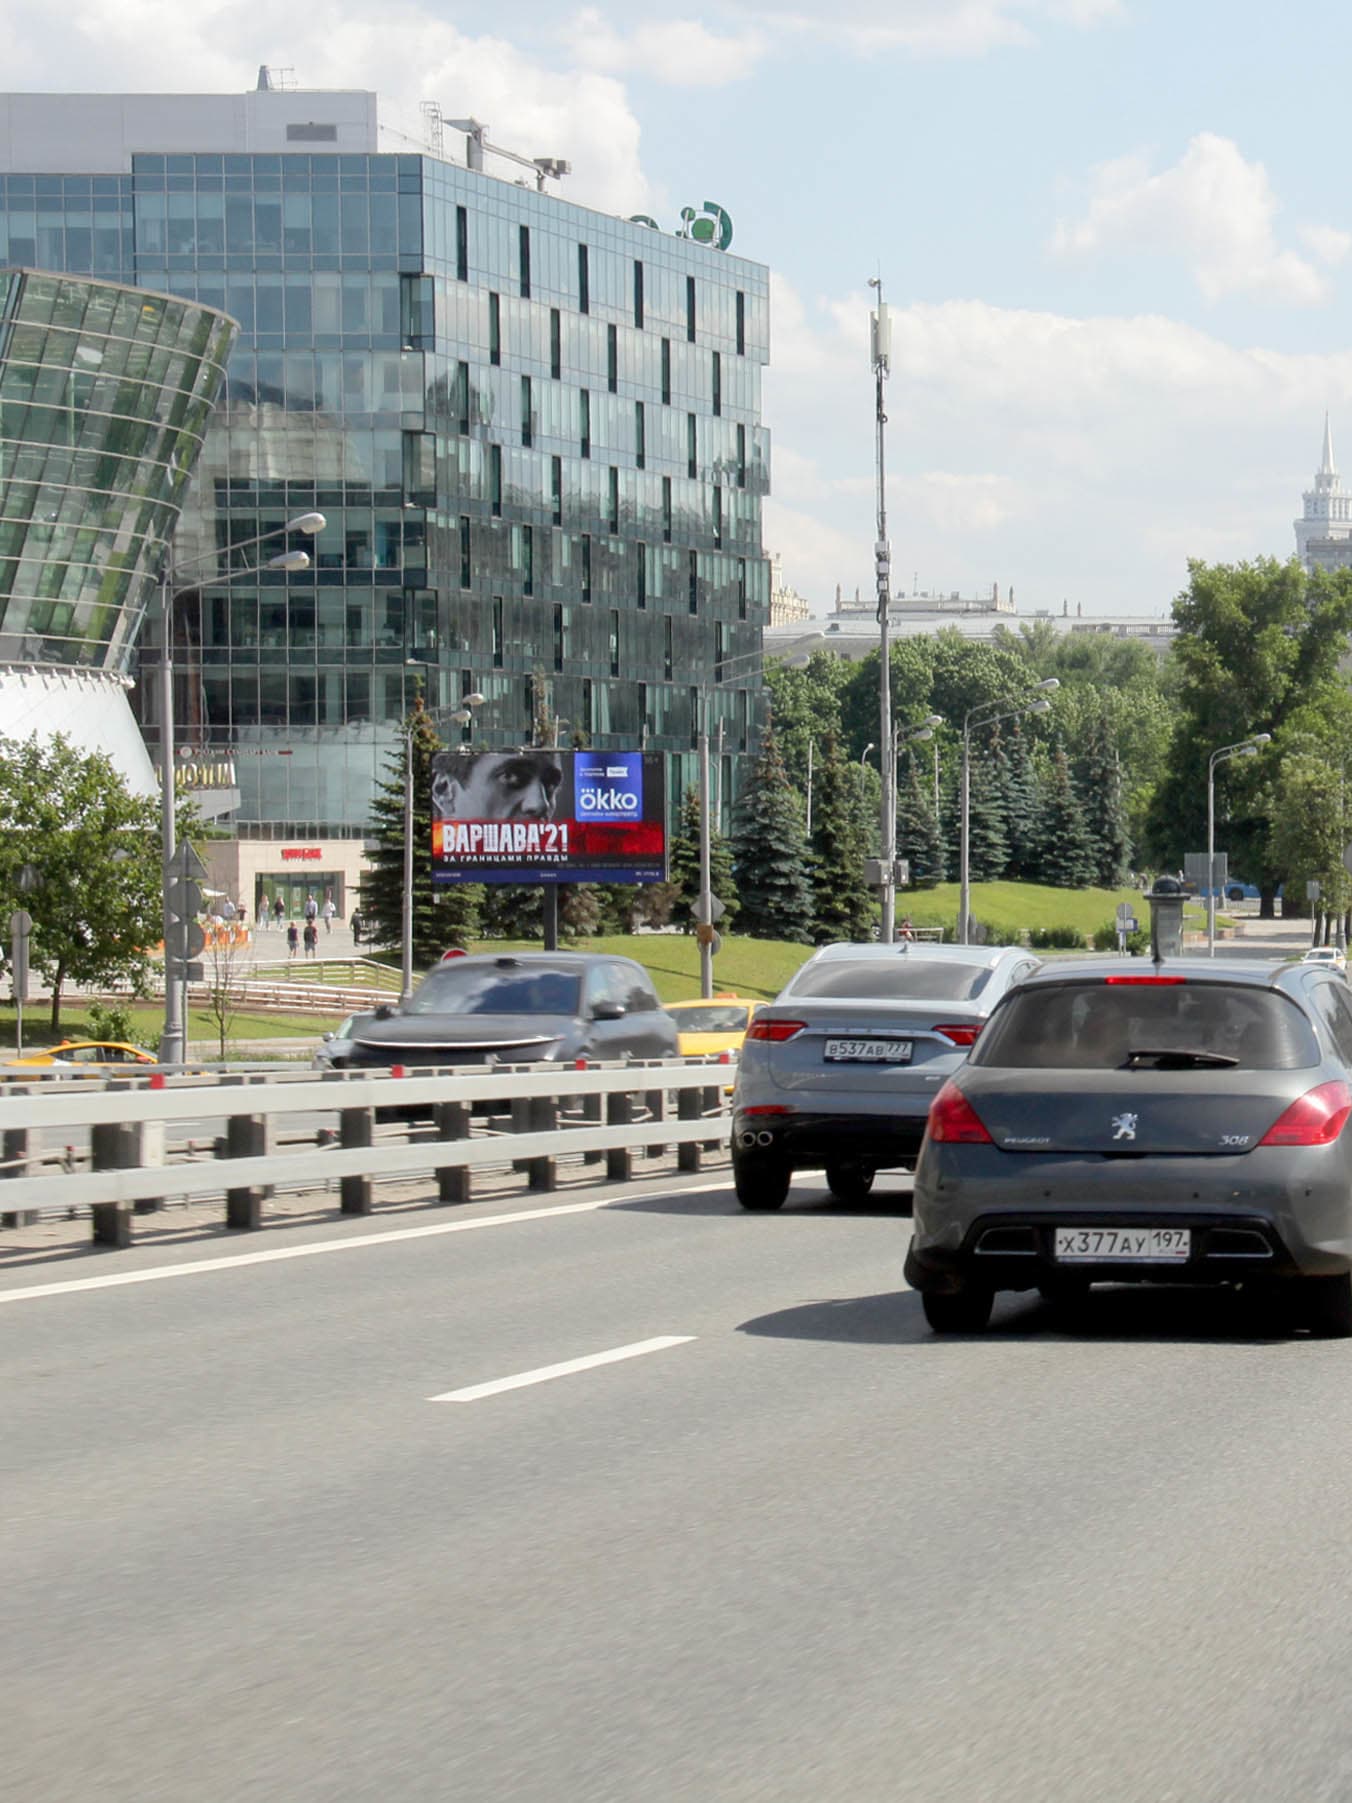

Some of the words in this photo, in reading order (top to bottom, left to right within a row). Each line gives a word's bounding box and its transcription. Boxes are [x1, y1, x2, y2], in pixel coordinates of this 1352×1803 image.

[580, 788, 638, 810] okko
[442, 823, 568, 853] ВАРШАВА'21
[830, 1042, 884, 1055] В537АВ
[1218, 1135, 1249, 1145] 308
[1063, 1231, 1146, 1253] Х377АУ
[1152, 1231, 1184, 1247] 197
